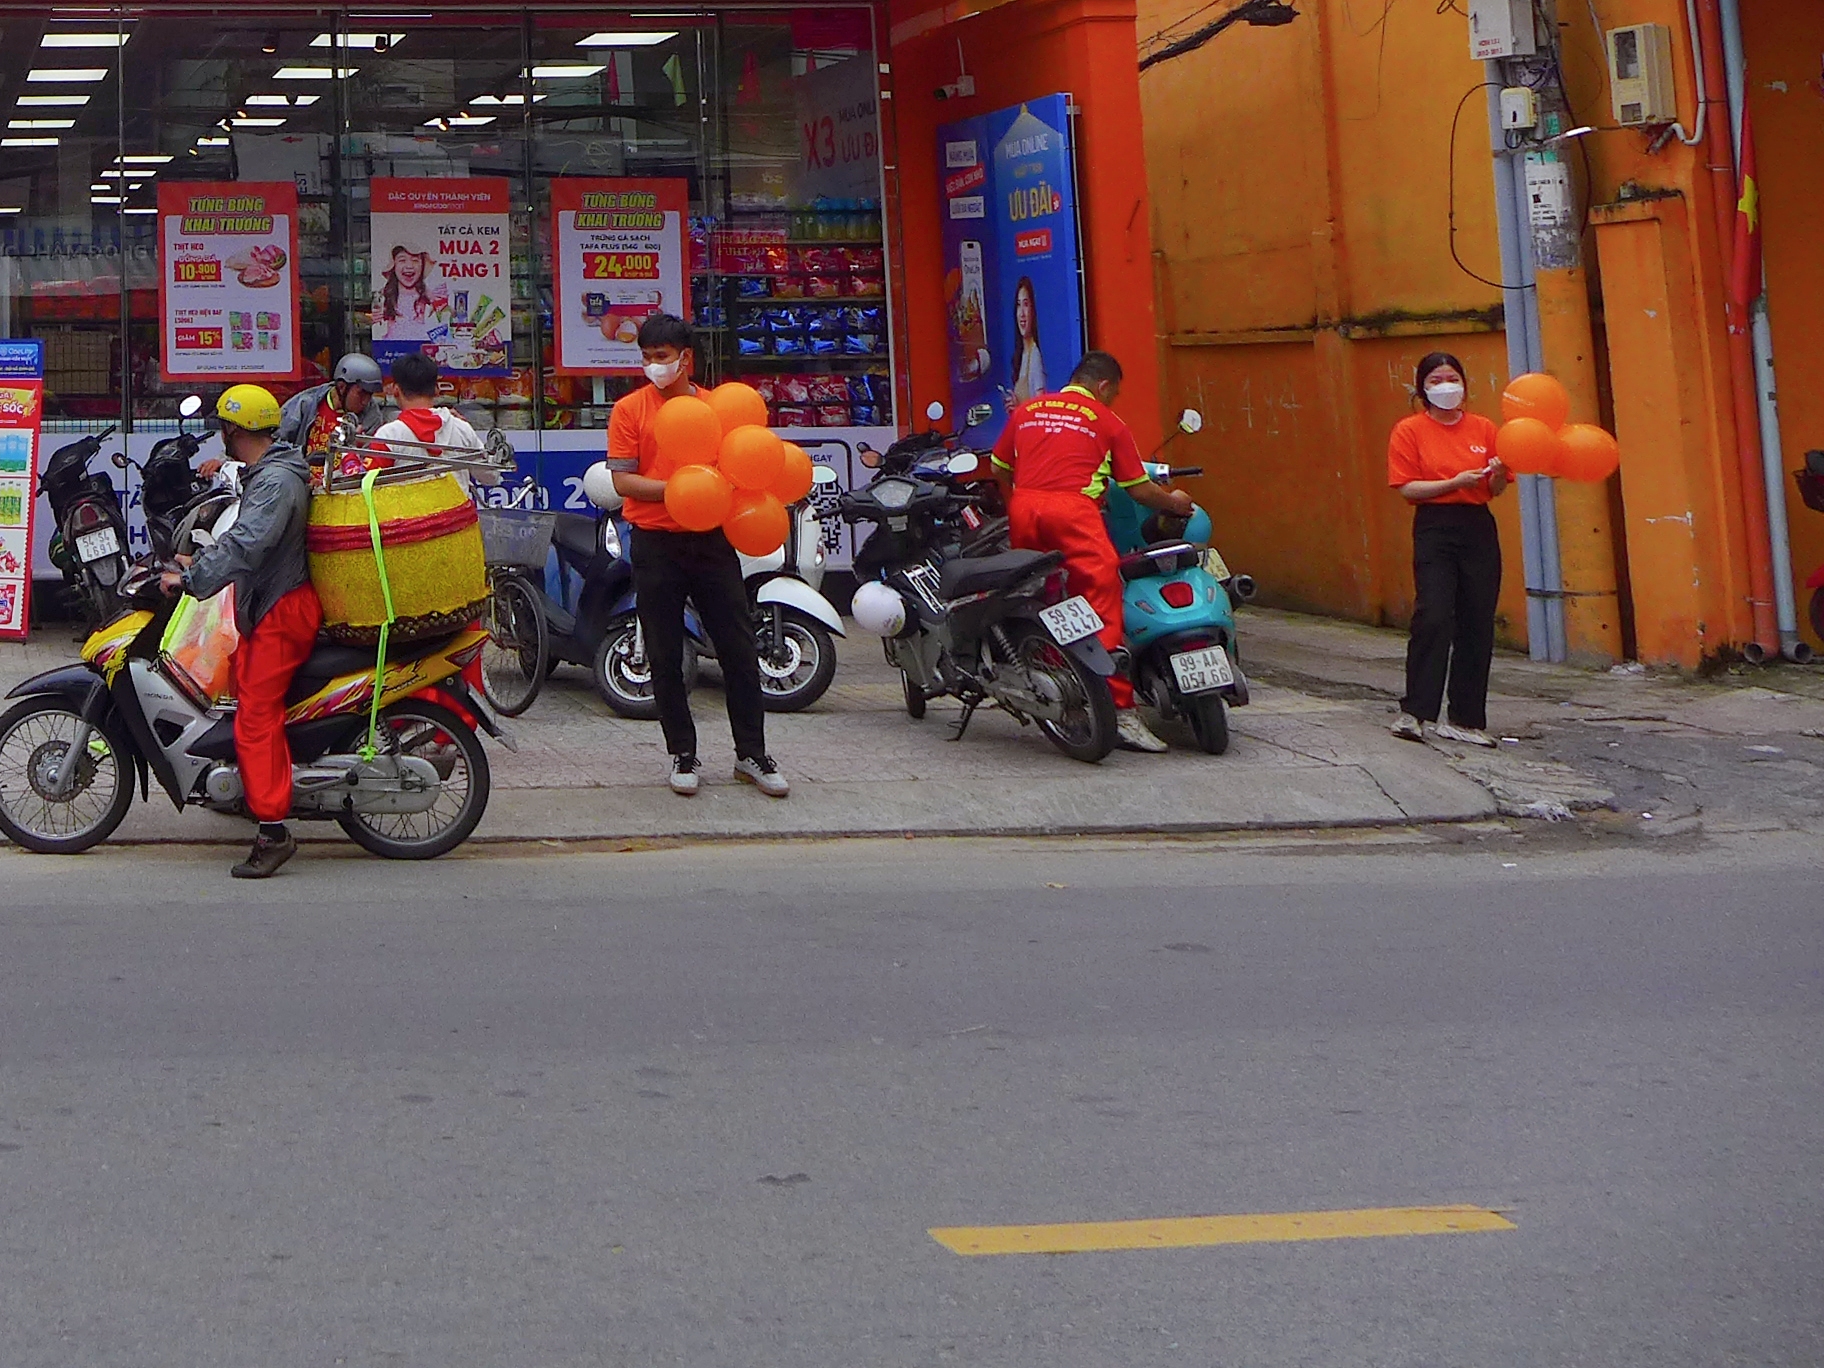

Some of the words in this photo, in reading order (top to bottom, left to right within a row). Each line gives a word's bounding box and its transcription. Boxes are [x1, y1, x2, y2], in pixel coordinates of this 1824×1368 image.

[1021, 133, 1049, 158] ONLINE
[1029, 180, 1053, 219] ĐÃI
[184, 217, 217, 232] KHAI
[577, 213, 608, 228] KHAI
[438, 223, 456, 235] TẤT
[458, 222, 474, 236] CẢ
[477, 226, 500, 235] KEM
[439, 240, 484, 255] MUA
[489, 240, 499, 255] 2
[438, 259, 489, 282] TẶNG
[493, 262, 500, 278] 1
[593, 253, 652, 278] 24.000
[198, 330, 221, 346] 15%
[2, 400, 25, 415] SỐC
[807, 454, 833, 463] GAY
[85, 541, 113, 558] 4691
